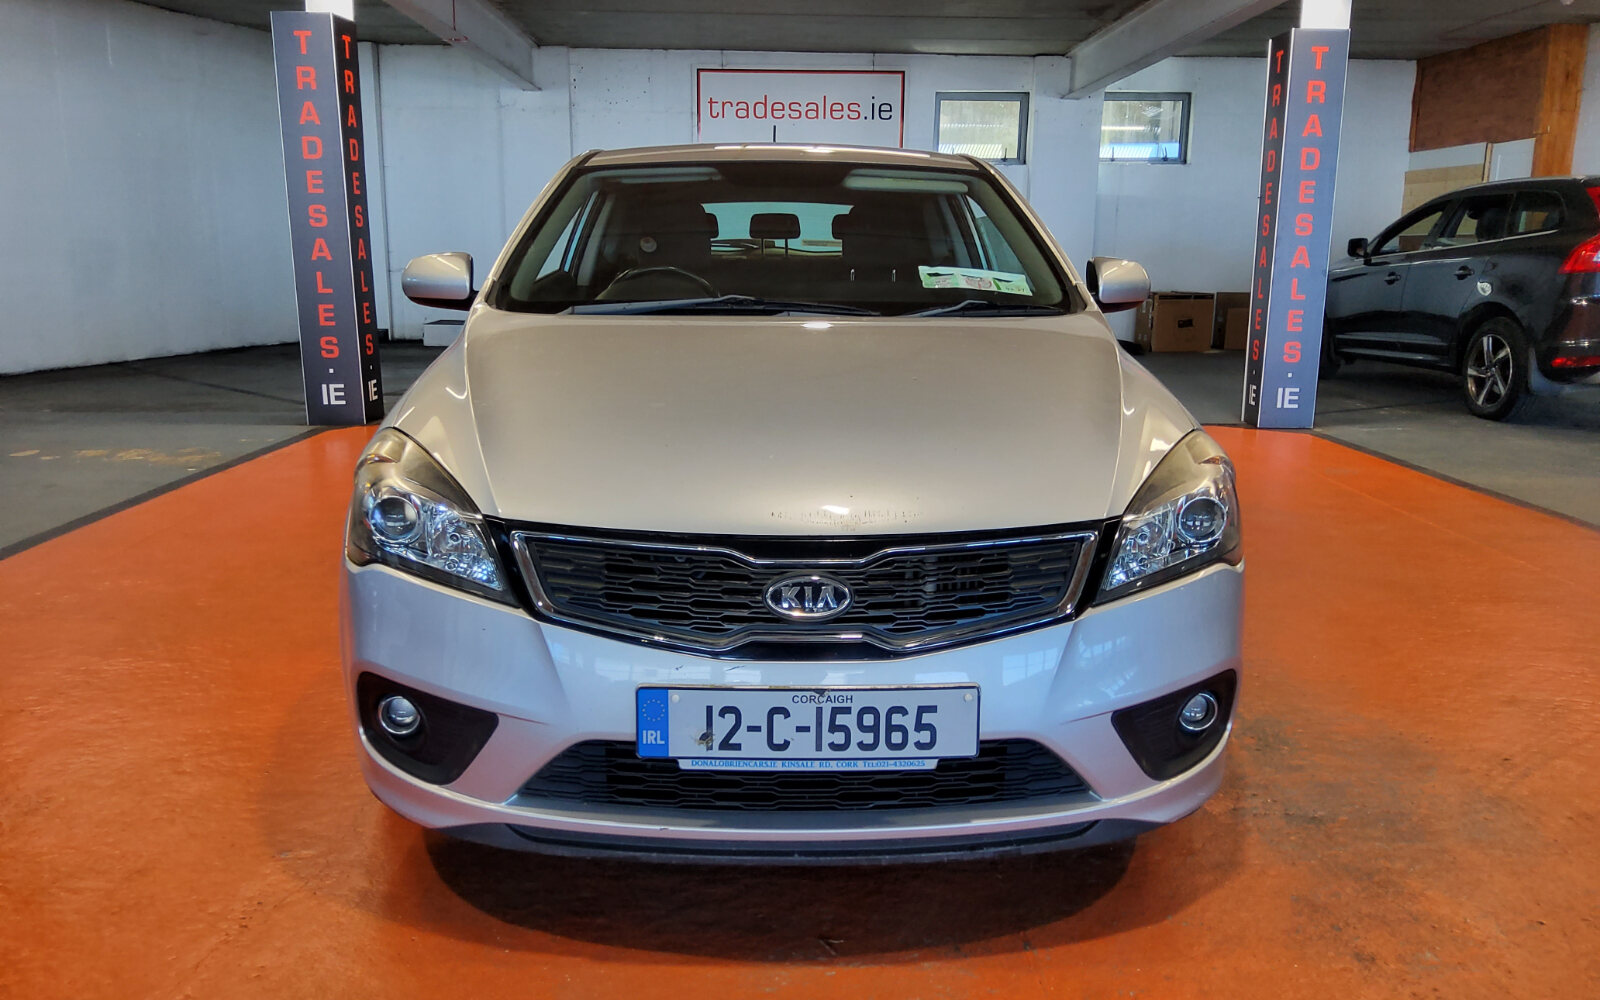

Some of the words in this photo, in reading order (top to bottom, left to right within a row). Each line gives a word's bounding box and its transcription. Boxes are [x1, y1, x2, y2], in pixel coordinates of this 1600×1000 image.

[707, 94, 893, 121] tradesales.ie
[780, 586, 838, 608] KIA
[791, 694, 853, 704] CORCAIGH
[642, 729, 665, 745] IRL
[703, 705, 938, 752] 12-C-15965
[781, 760, 814, 769] KINSALE
[836, 760, 858, 768] CORK
